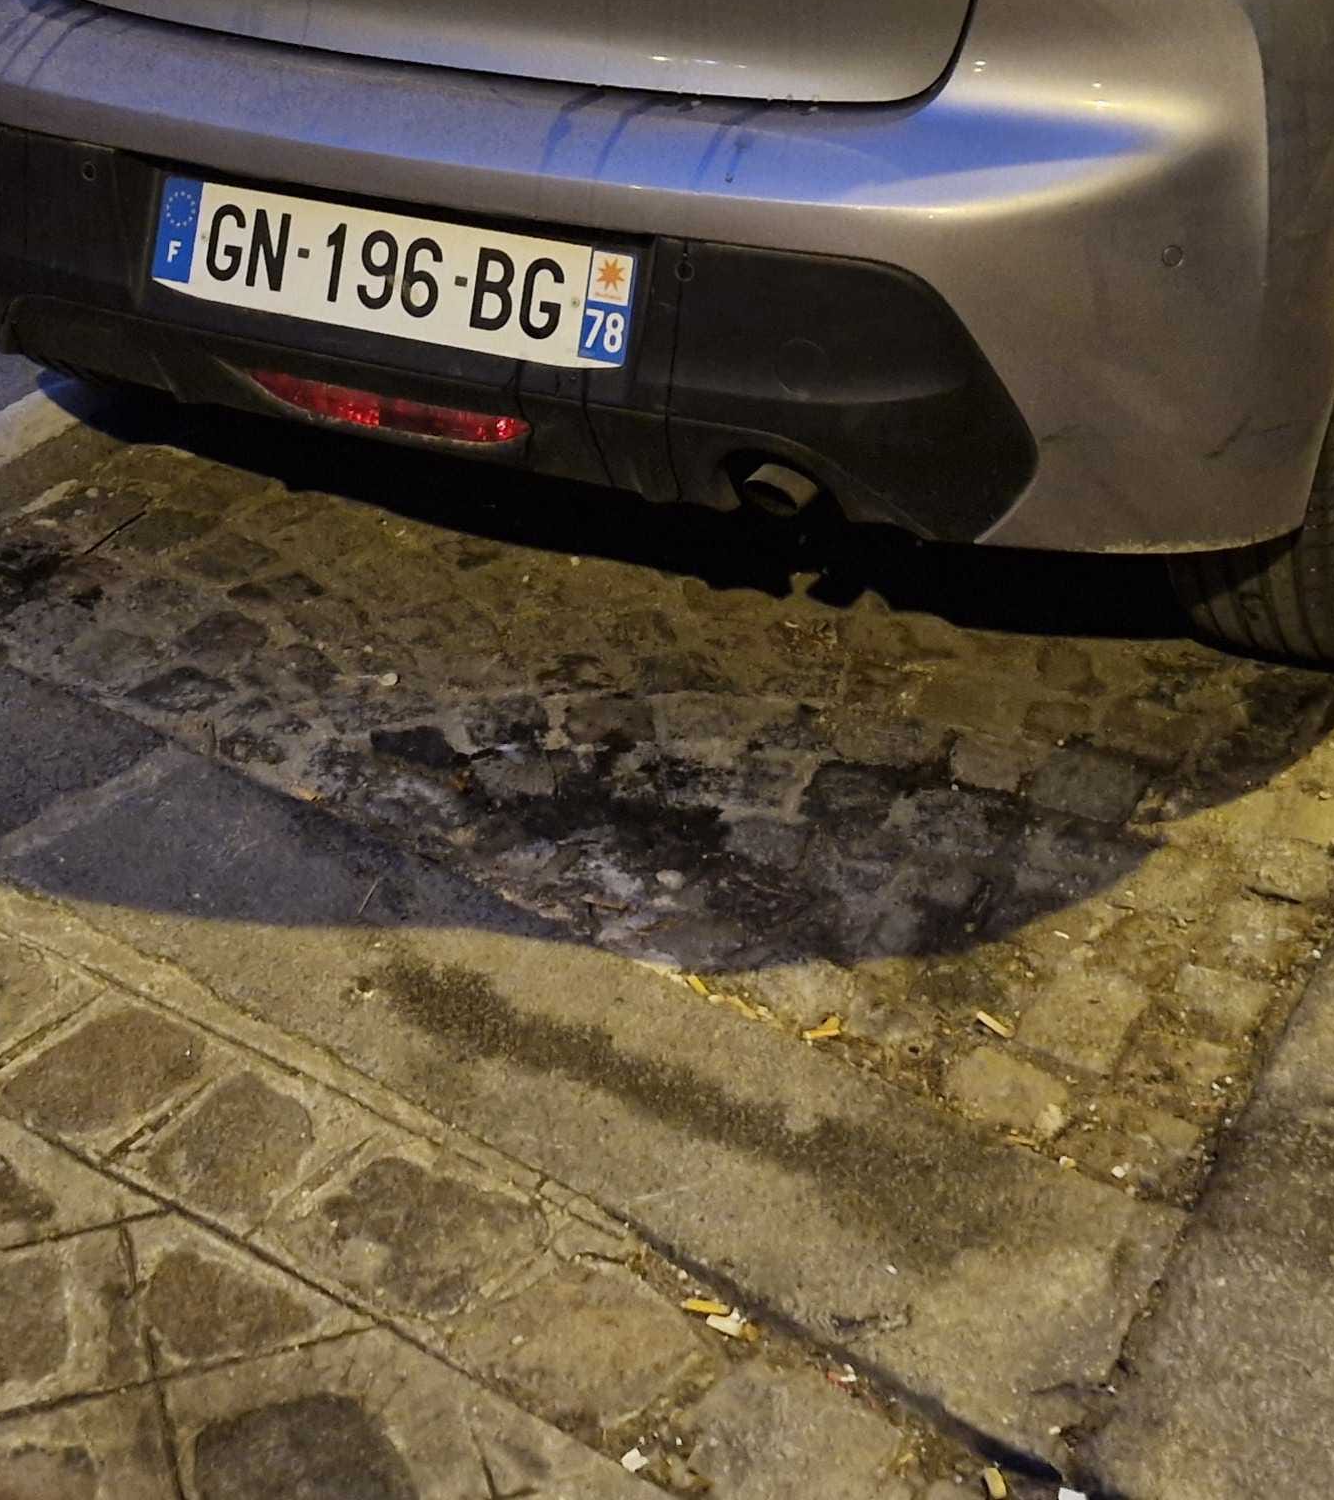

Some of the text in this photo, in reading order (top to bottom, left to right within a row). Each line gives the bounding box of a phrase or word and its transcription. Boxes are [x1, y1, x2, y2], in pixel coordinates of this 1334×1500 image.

[167, 240, 182, 263] F
[204, 203, 565, 340] GN-196-BG
[584, 308, 625, 353] 78
